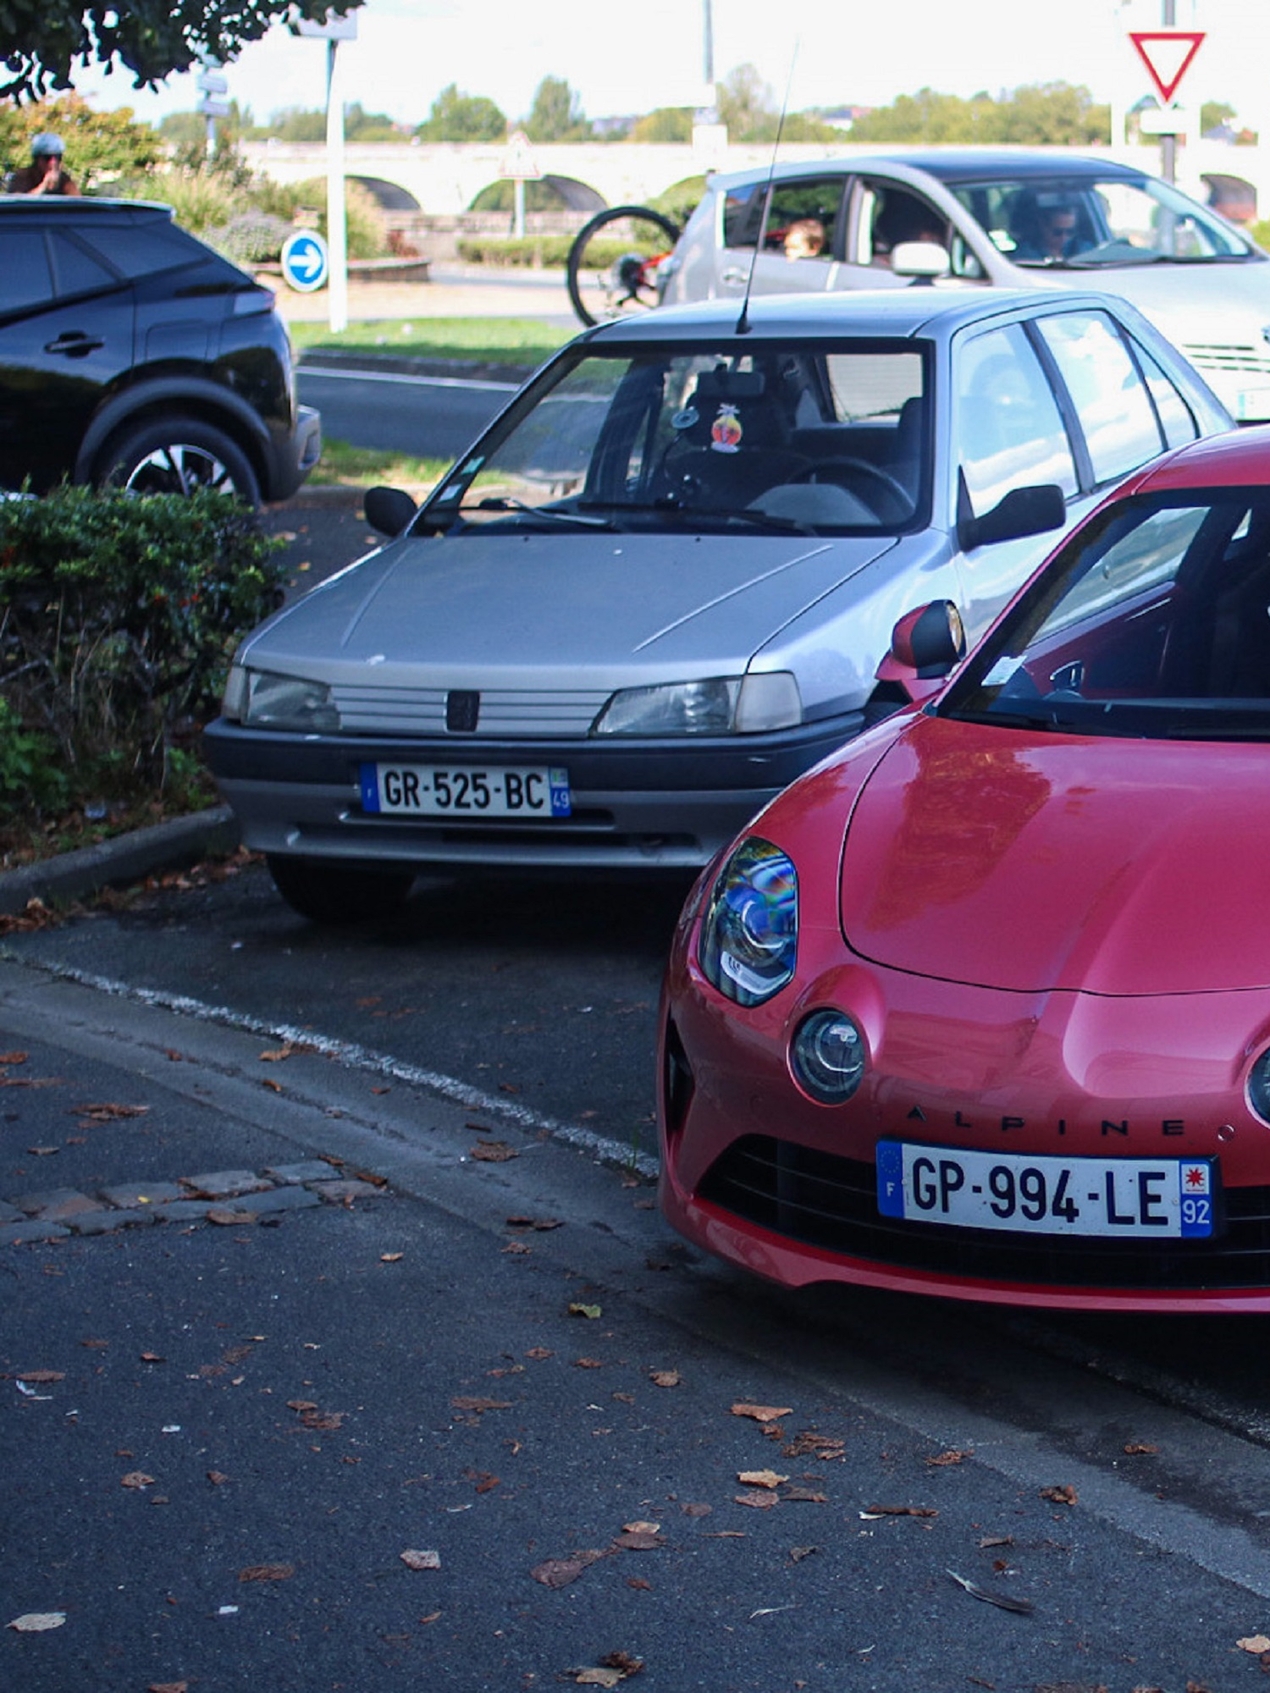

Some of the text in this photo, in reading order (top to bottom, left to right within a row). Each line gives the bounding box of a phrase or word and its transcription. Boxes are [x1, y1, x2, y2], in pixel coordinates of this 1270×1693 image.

[384, 771, 544, 809] GR-525-BC
[553, 790, 569, 808] 49
[907, 1105, 1185, 1136] ALPINE
[886, 1182, 894, 1197] F
[912, 1157, 1169, 1226] GP-994-LE
[1182, 1199, 1210, 1224] 92
